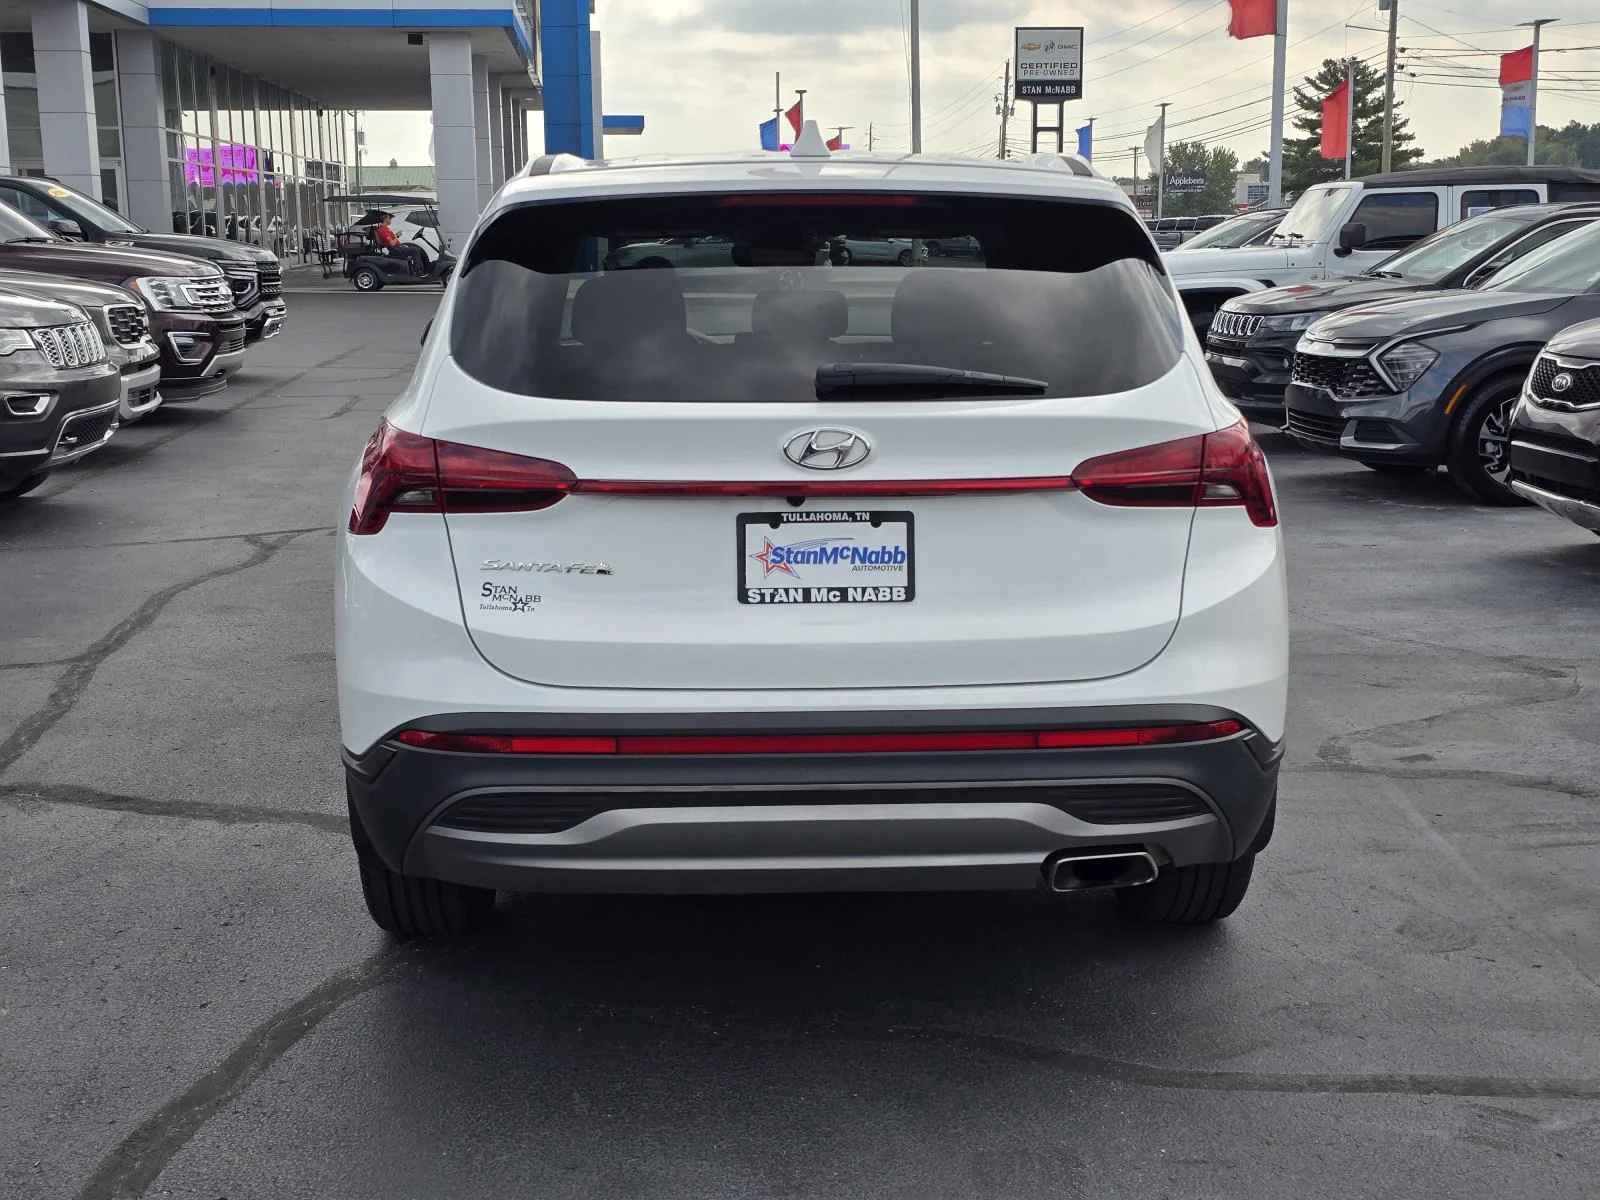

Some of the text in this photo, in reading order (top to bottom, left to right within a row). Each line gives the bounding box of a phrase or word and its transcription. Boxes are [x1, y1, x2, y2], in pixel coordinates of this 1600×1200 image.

[1022, 85, 1076, 94] STAN McNABB
[781, 512, 870, 522] TULLAHOMA, TN
[481, 581, 518, 597] STAN
[747, 587, 906, 603] STAN Mc NABB
